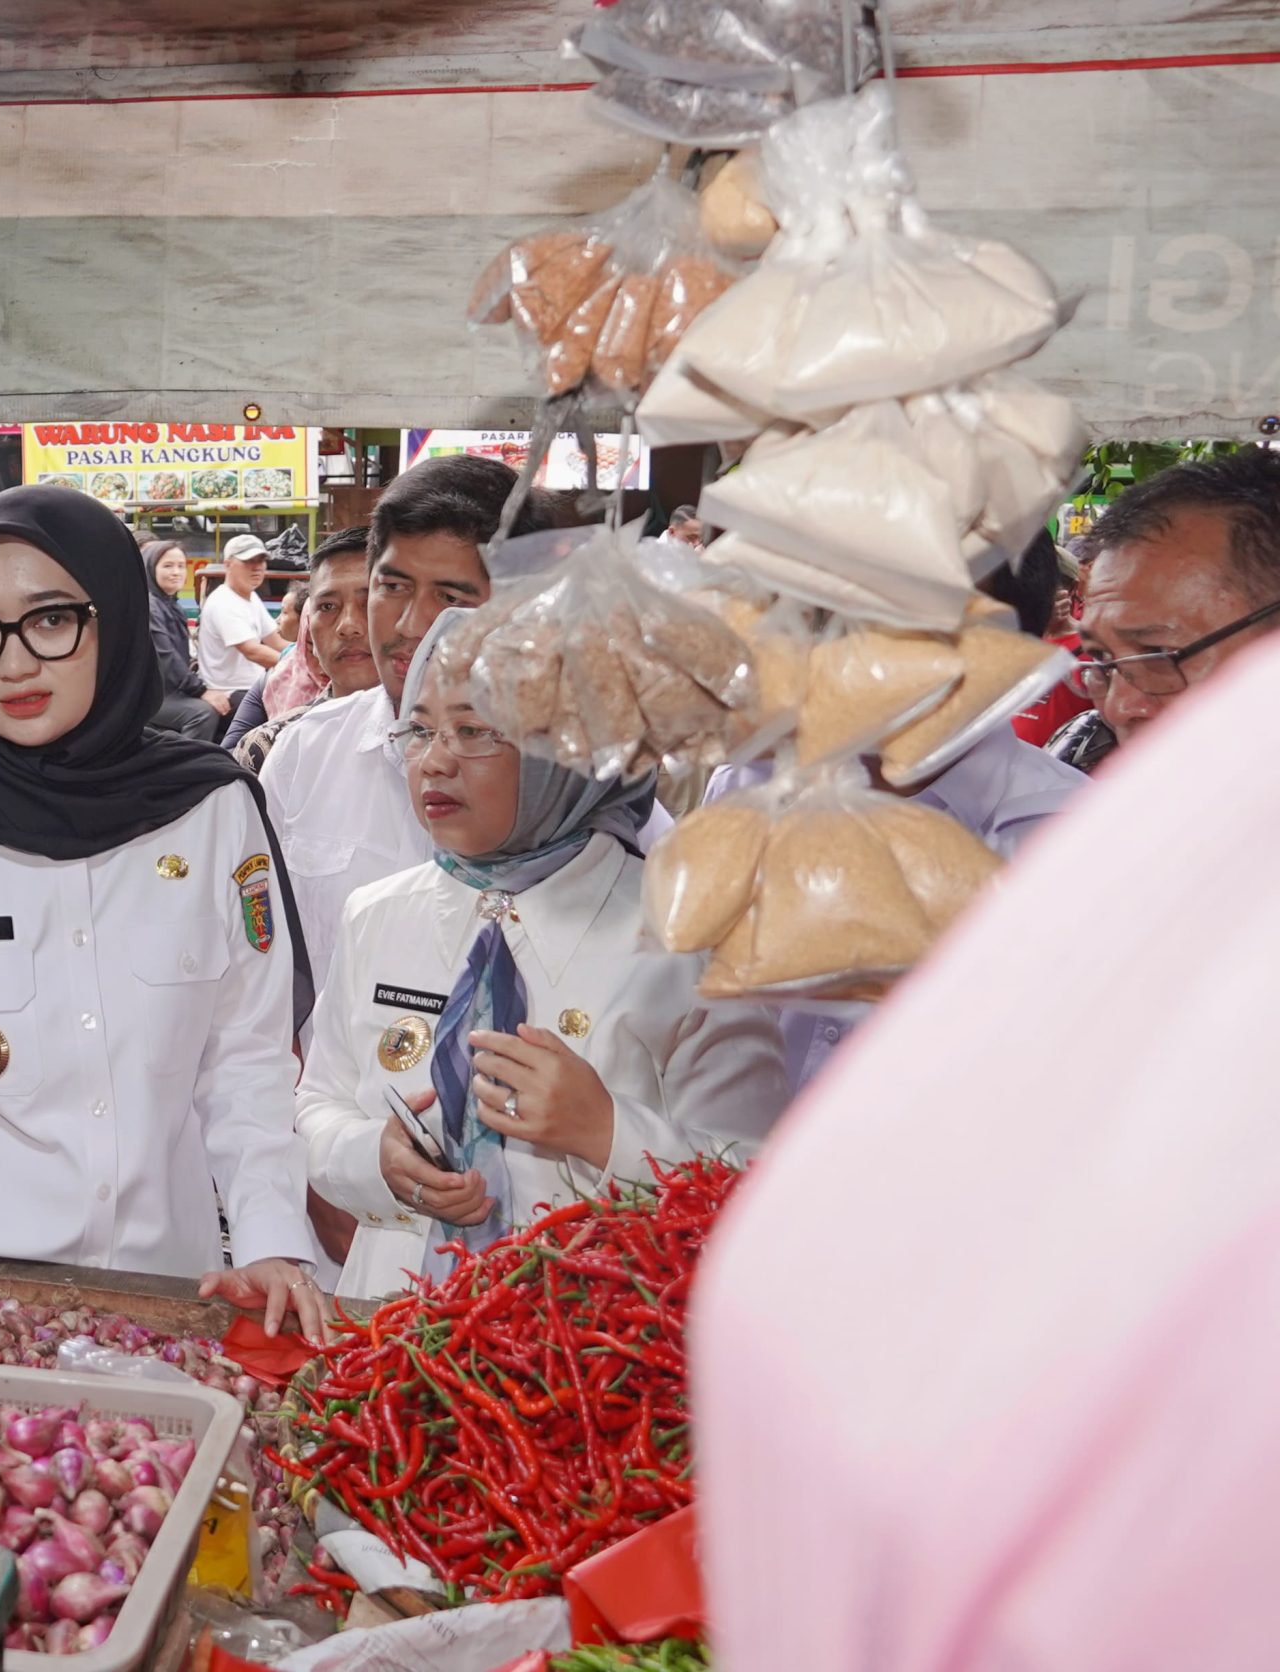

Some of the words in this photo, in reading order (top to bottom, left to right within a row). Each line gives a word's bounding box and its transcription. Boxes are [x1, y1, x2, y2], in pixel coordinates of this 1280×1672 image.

[34, 424, 160, 446] WARUNG
[167, 423, 235, 443] NASI
[480, 432, 525, 441] PASAR
[66, 449, 133, 465] PASAR
[140, 446, 261, 464] KANGKUNG
[377, 989, 396, 1001] EVIE
[396, 992, 444, 1009] FATMAWATY
